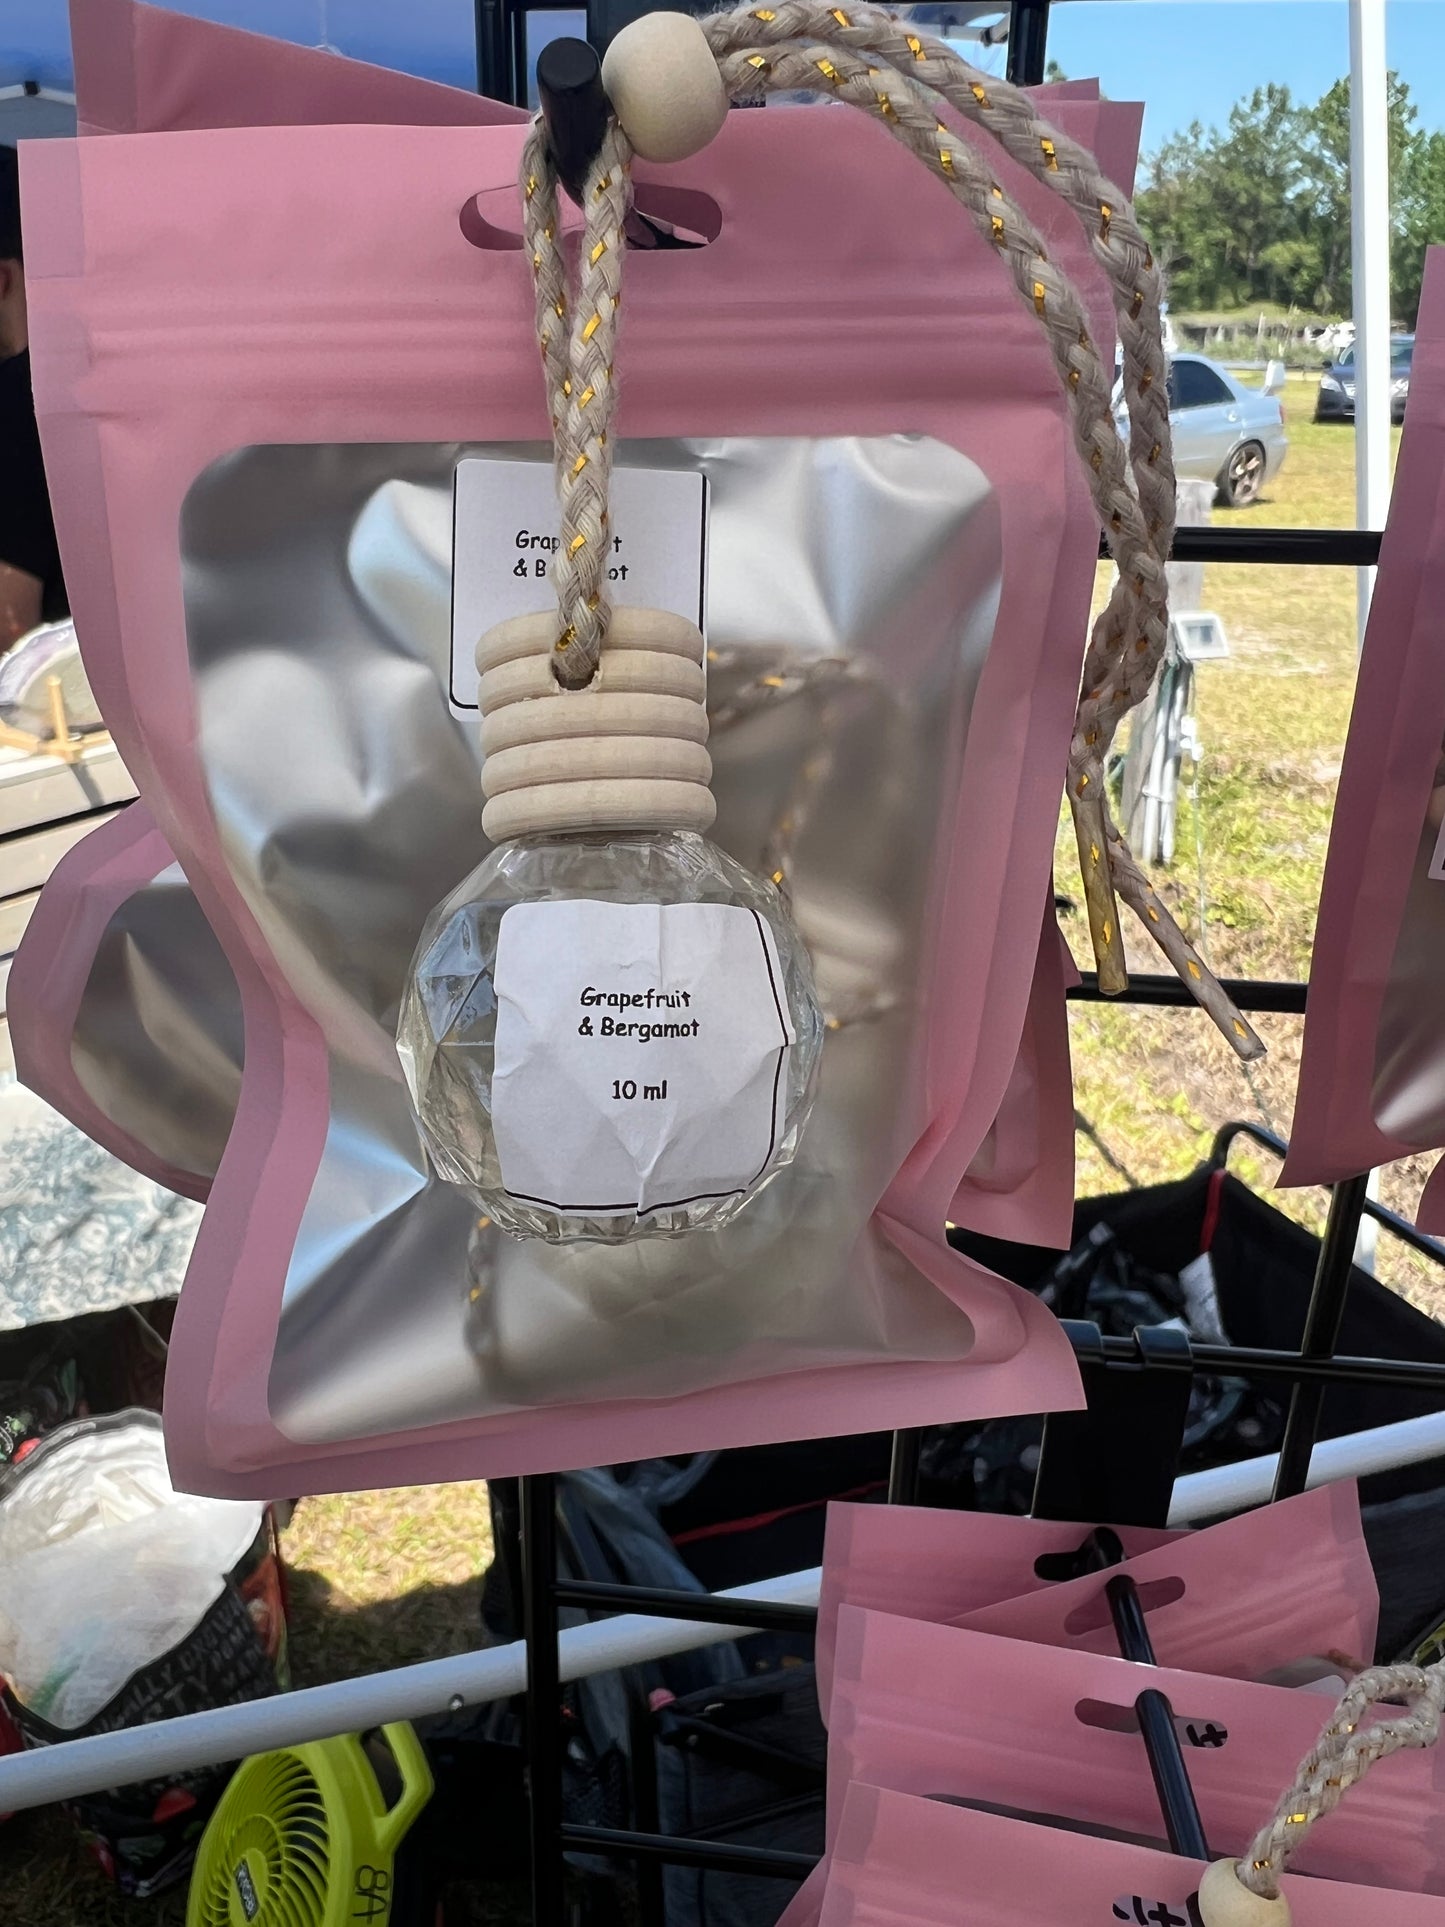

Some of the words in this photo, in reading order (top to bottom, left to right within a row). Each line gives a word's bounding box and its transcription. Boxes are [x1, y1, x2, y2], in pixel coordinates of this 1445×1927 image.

[515, 529, 622, 554] Grapt
[513, 558, 528, 577] &
[580, 986, 691, 1013] Grapefruit
[578, 1016, 594, 1036] &
[600, 1016, 700, 1043] Bergamot
[612, 1080, 637, 1100] 10
[643, 1080, 667, 1101] ml
